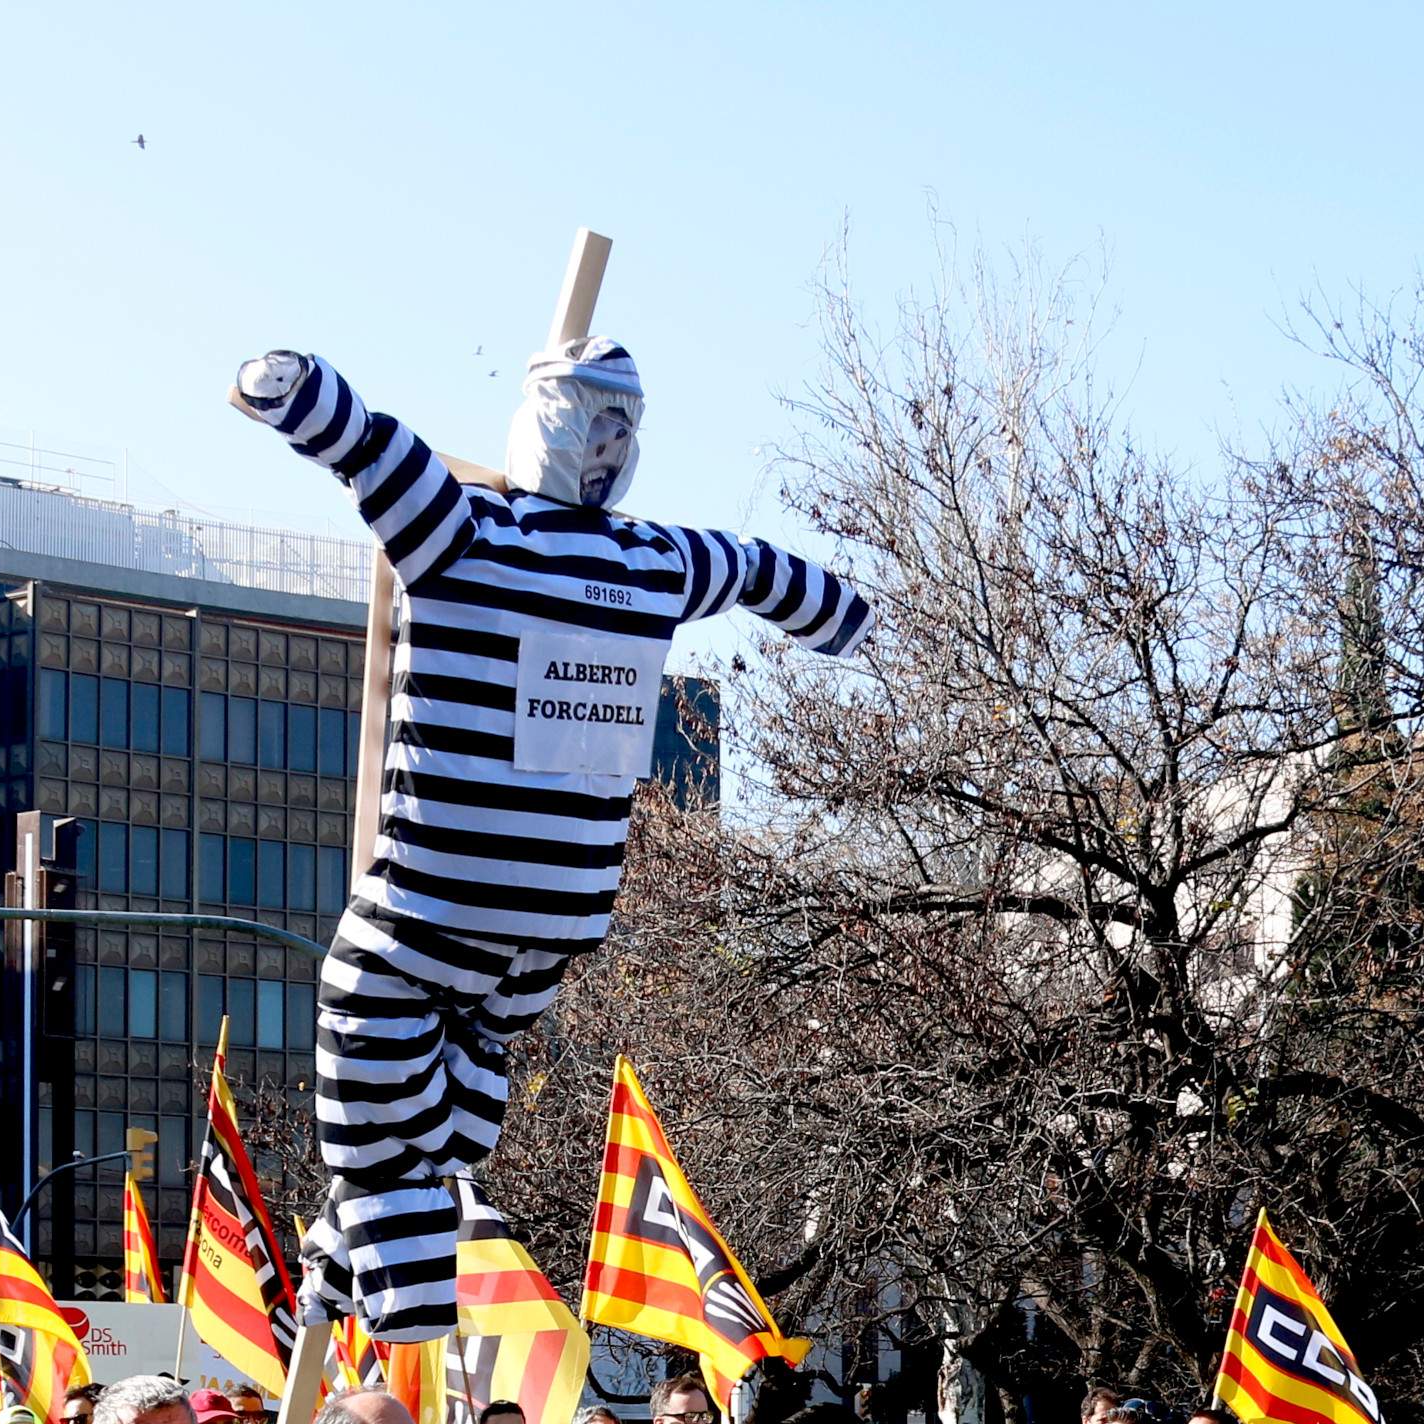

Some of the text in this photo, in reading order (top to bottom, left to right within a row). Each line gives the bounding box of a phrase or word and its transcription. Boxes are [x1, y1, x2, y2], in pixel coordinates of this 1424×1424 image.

[584, 585, 633, 606] 691692
[544, 661, 637, 686] ALBERTO
[527, 697, 645, 725] FORCADELL
[91, 1328, 113, 1343] DS
[82, 1340, 127, 1356] Smith
